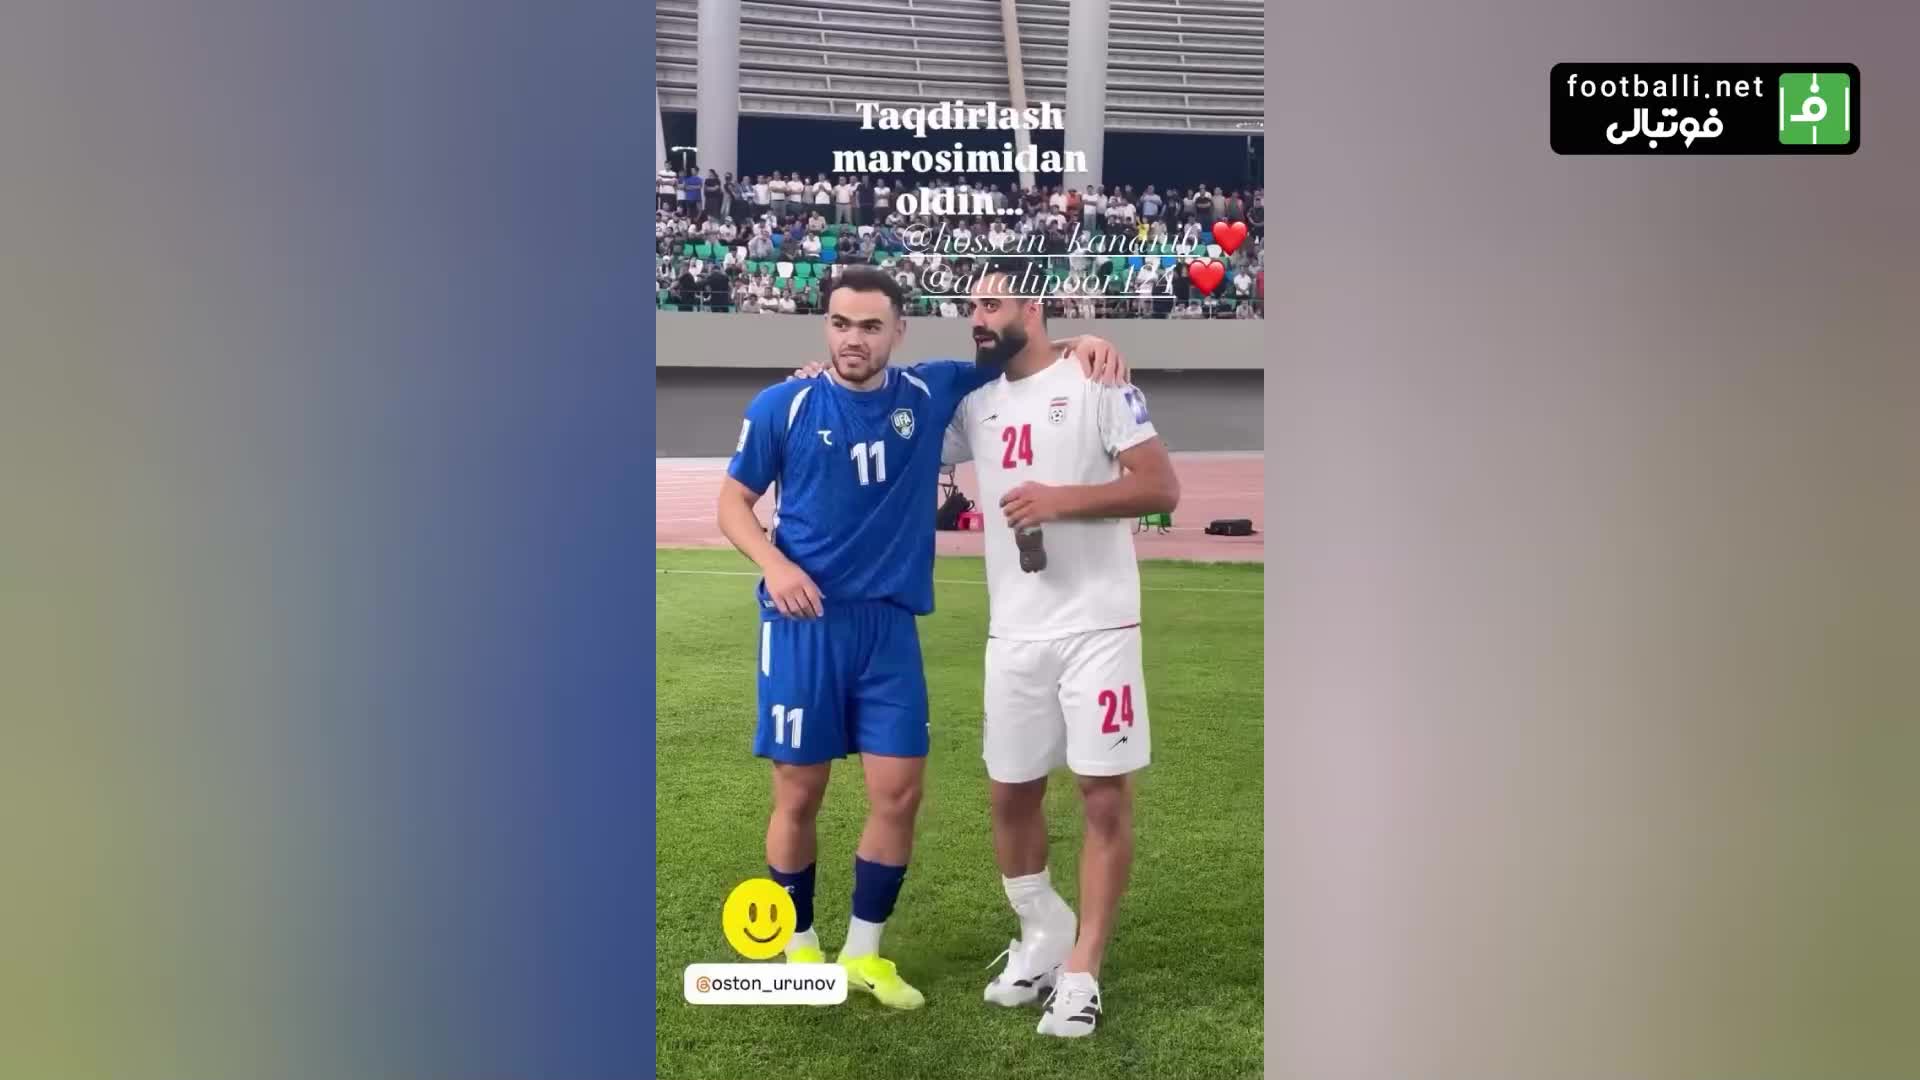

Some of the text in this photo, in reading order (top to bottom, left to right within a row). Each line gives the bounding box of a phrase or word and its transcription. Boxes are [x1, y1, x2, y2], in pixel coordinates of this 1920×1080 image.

[850, 440, 886, 486] 11
[1002, 424, 1033, 469] 24
[771, 704, 803, 748] 11
[1098, 684, 1133, 733] 24
